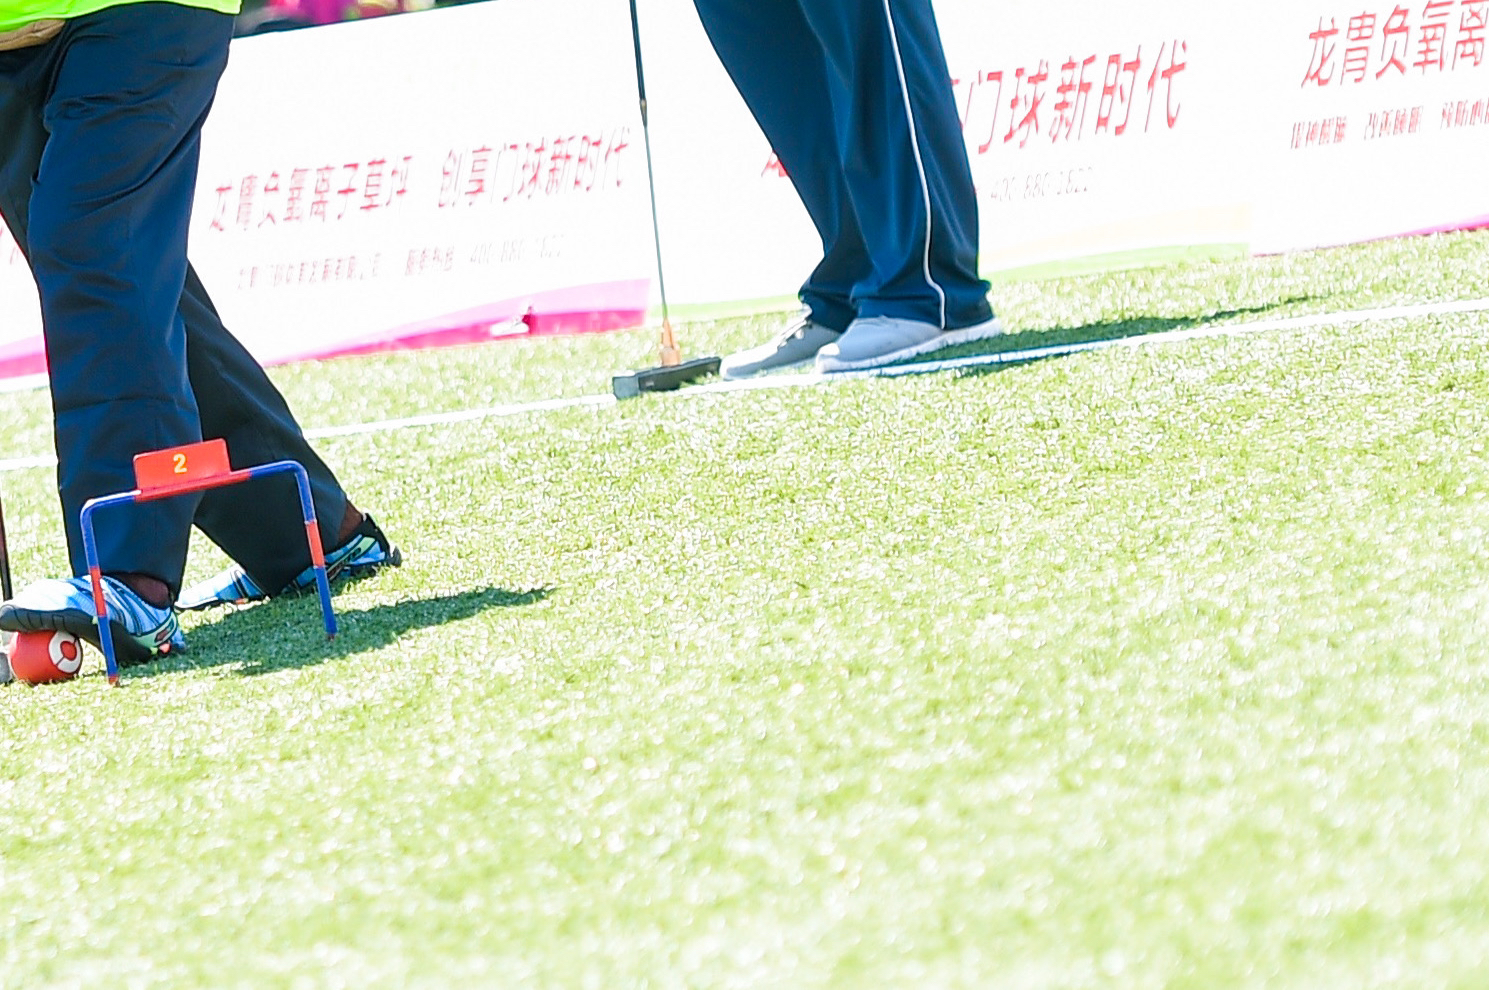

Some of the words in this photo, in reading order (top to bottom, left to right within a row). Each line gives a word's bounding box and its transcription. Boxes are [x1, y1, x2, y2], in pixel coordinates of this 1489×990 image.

[950, 38, 1187, 155] 门球新时代
[173, 453, 188, 474] 2
